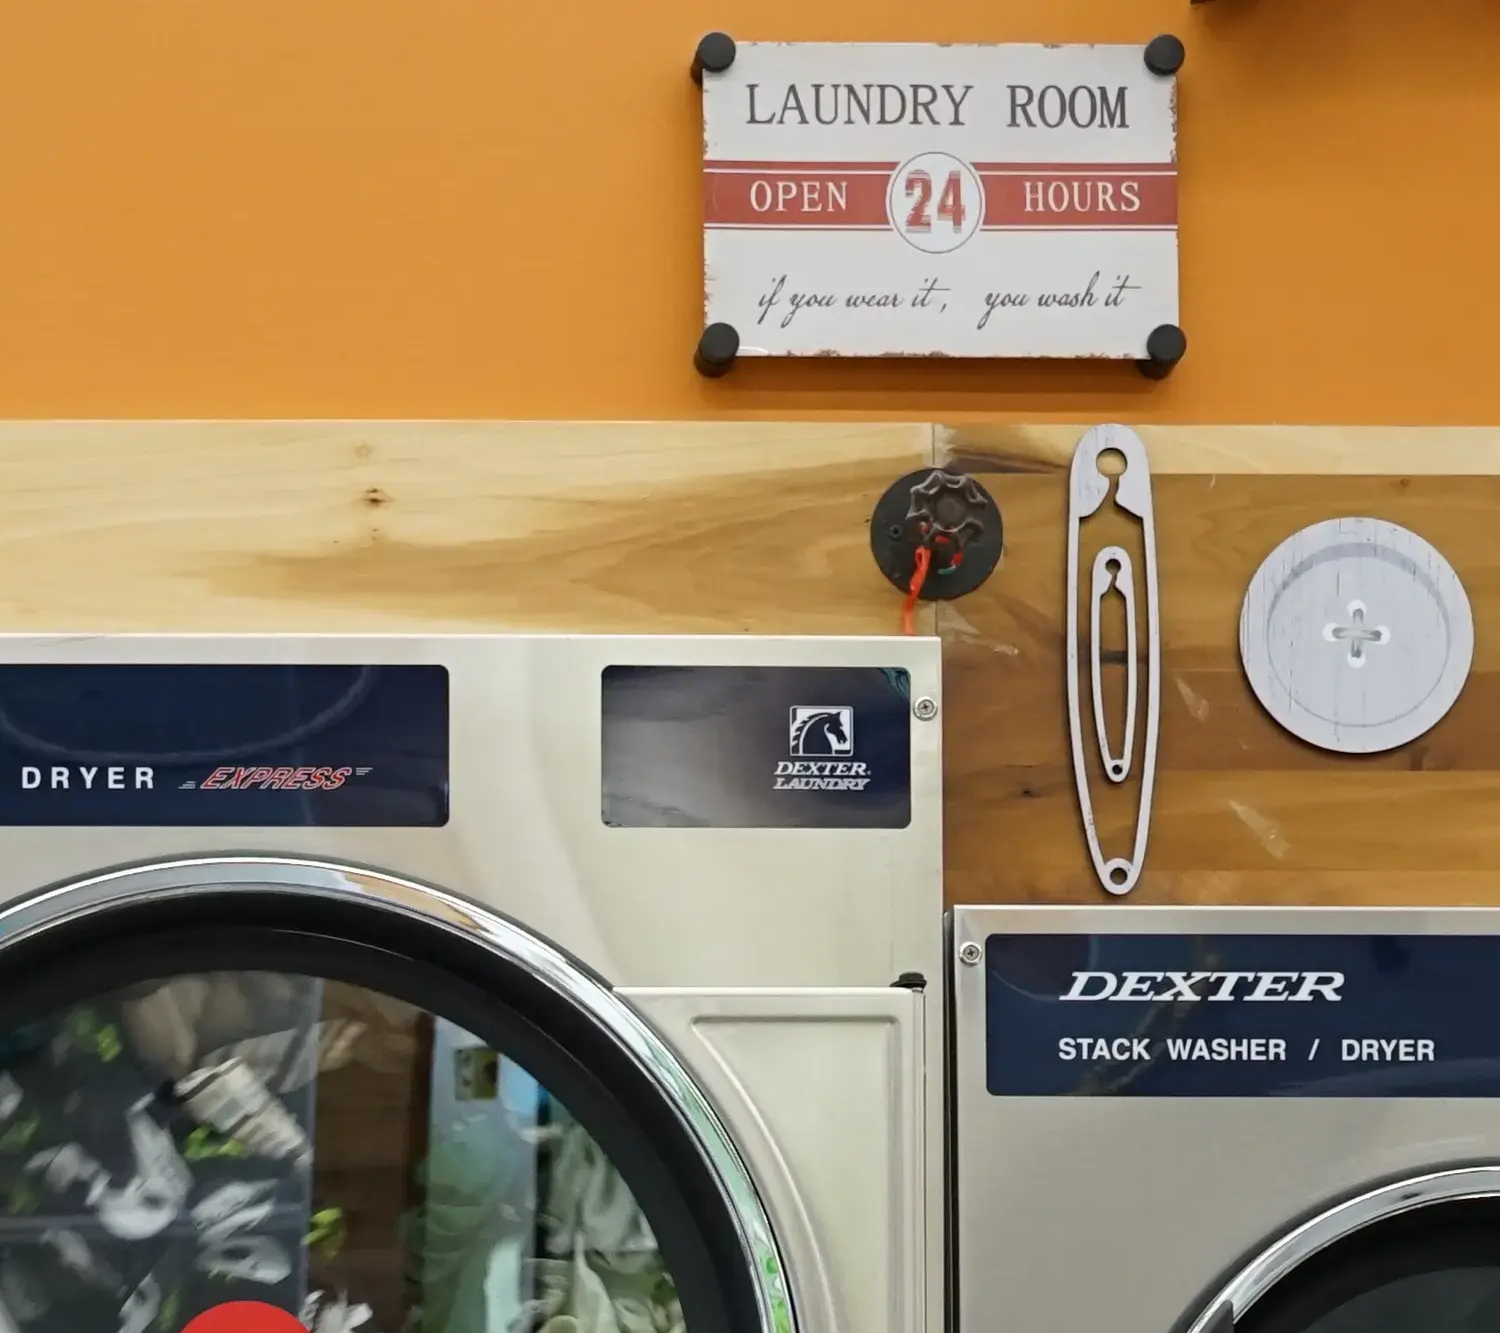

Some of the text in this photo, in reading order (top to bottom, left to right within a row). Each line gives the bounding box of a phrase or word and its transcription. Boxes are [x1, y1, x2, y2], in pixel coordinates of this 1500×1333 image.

[747, 84, 1129, 128] LAUNDRY ROOM
[751, 169, 1139, 234] OPEN 24 HOURS
[757, 274, 788, 325] if
[781, 290, 833, 328] you
[845, 290, 903, 309] wear
[978, 291, 1029, 330] you
[1037, 270, 1098, 308] wash
[1104, 274, 1141, 308] it
[22, 767, 153, 788] DRYER
[199, 765, 359, 792] EXPRESS
[773, 761, 870, 775] DEXTER
[773, 778, 869, 790] LAUNDRY
[1059, 972, 1344, 1001] DEXTER
[1059, 1038, 1150, 1060] STACK
[1167, 1039, 1286, 1060] WASHER
[1342, 1040, 1434, 1060] DRYER
